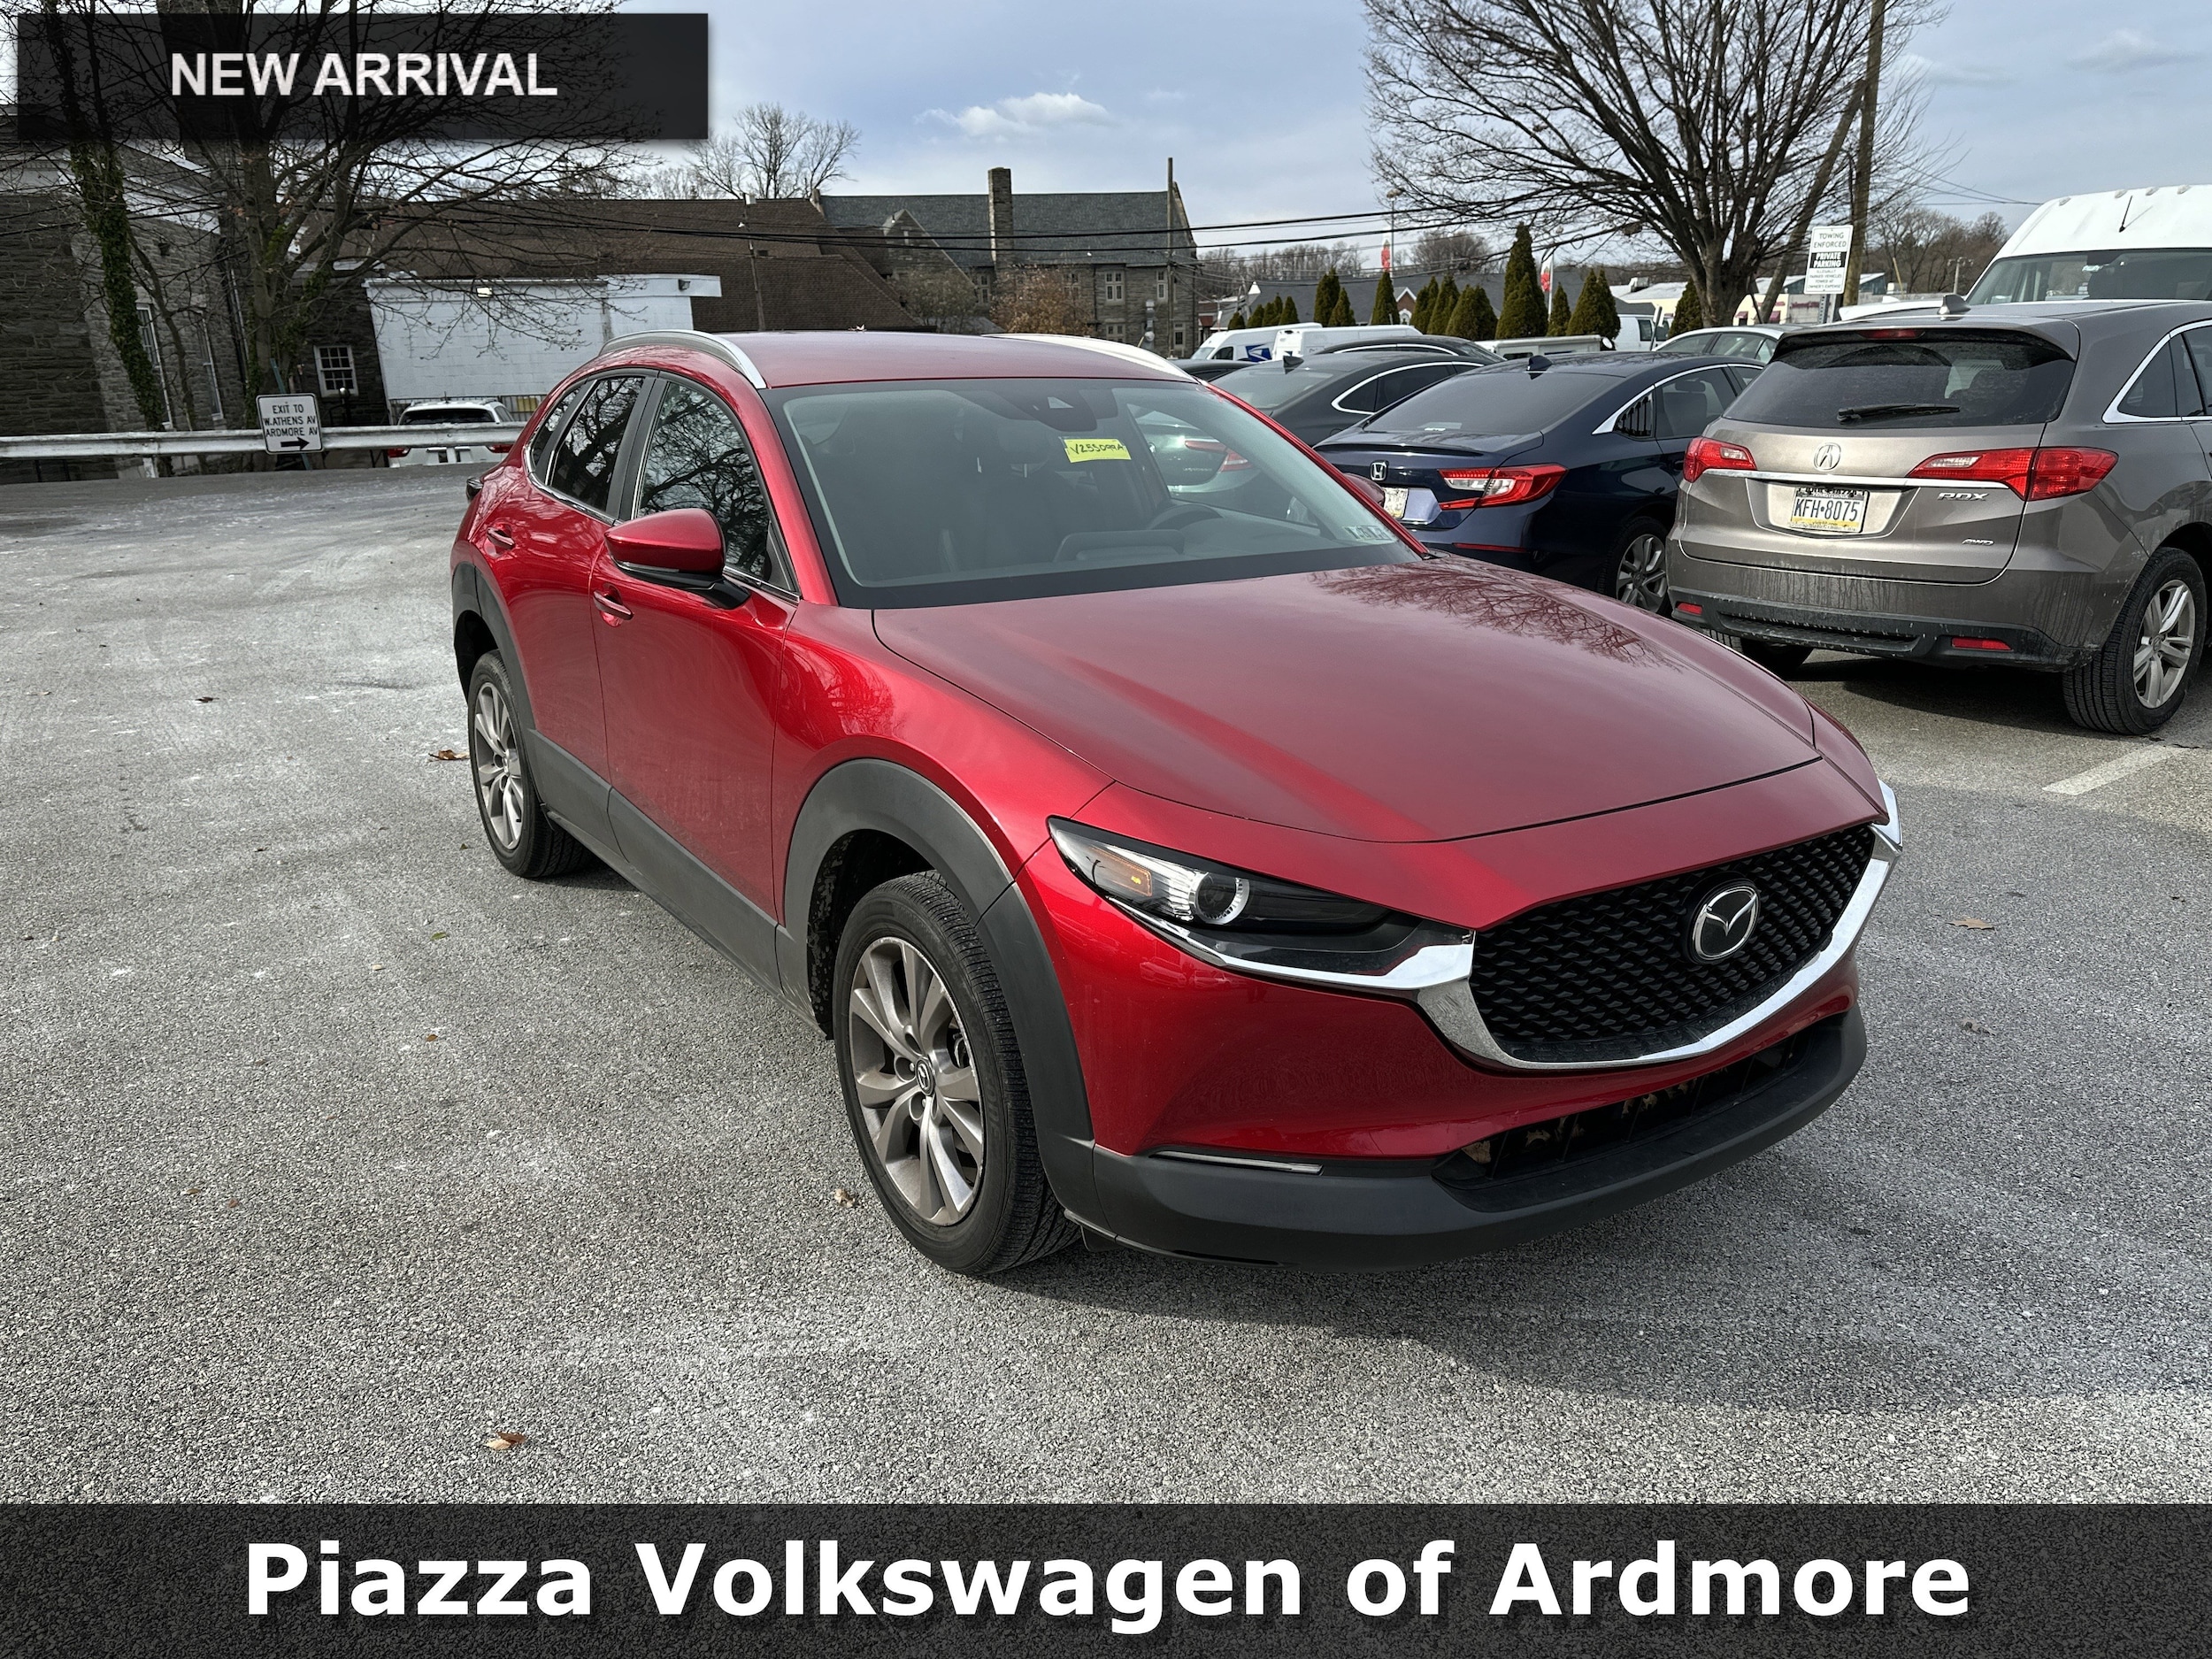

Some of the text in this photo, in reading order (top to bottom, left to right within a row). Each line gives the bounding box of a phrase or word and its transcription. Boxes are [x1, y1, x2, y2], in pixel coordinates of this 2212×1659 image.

[1813, 259, 1842, 268] PARKING
[272, 403, 303, 414] EXIT TO
[263, 415, 316, 426] W.ATHENS AV
[265, 426, 318, 437] ARDMORE AV
[1937, 492, 1989, 502] RDX
[1962, 538, 1994, 547] AWD
